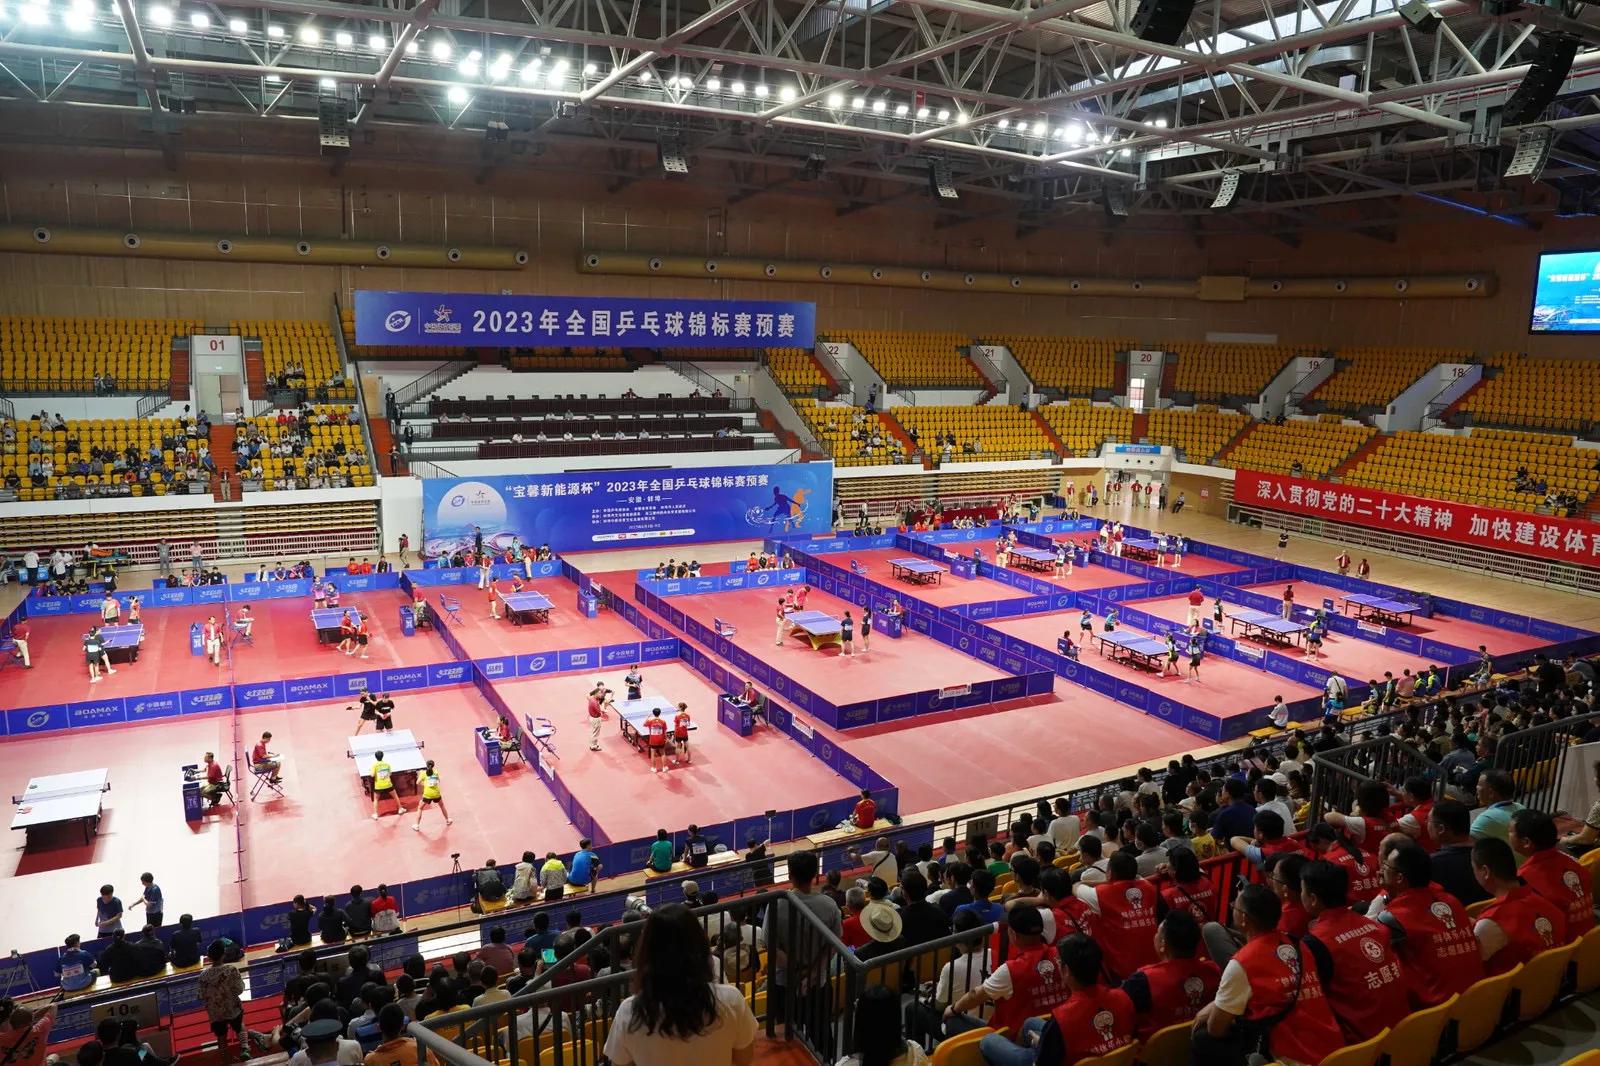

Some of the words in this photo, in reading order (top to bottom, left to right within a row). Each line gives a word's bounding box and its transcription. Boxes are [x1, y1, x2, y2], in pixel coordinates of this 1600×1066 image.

[472, 308, 796, 338] 2023年全国乒乓球锦标赛预赛
[210, 339, 225, 351] 01
[828, 345, 839, 355] 22
[1140, 353, 1152, 362] 20
[1308, 360, 1319, 370] 19
[1452, 367, 1465, 378] 18
[505, 481, 600, 499] “宝馨新能源杯”
[606, 474, 769, 493] 2023年全国乒乓球锦标赛预赛
[1256, 479, 1453, 532] 深入贯彻党的二十大精神
